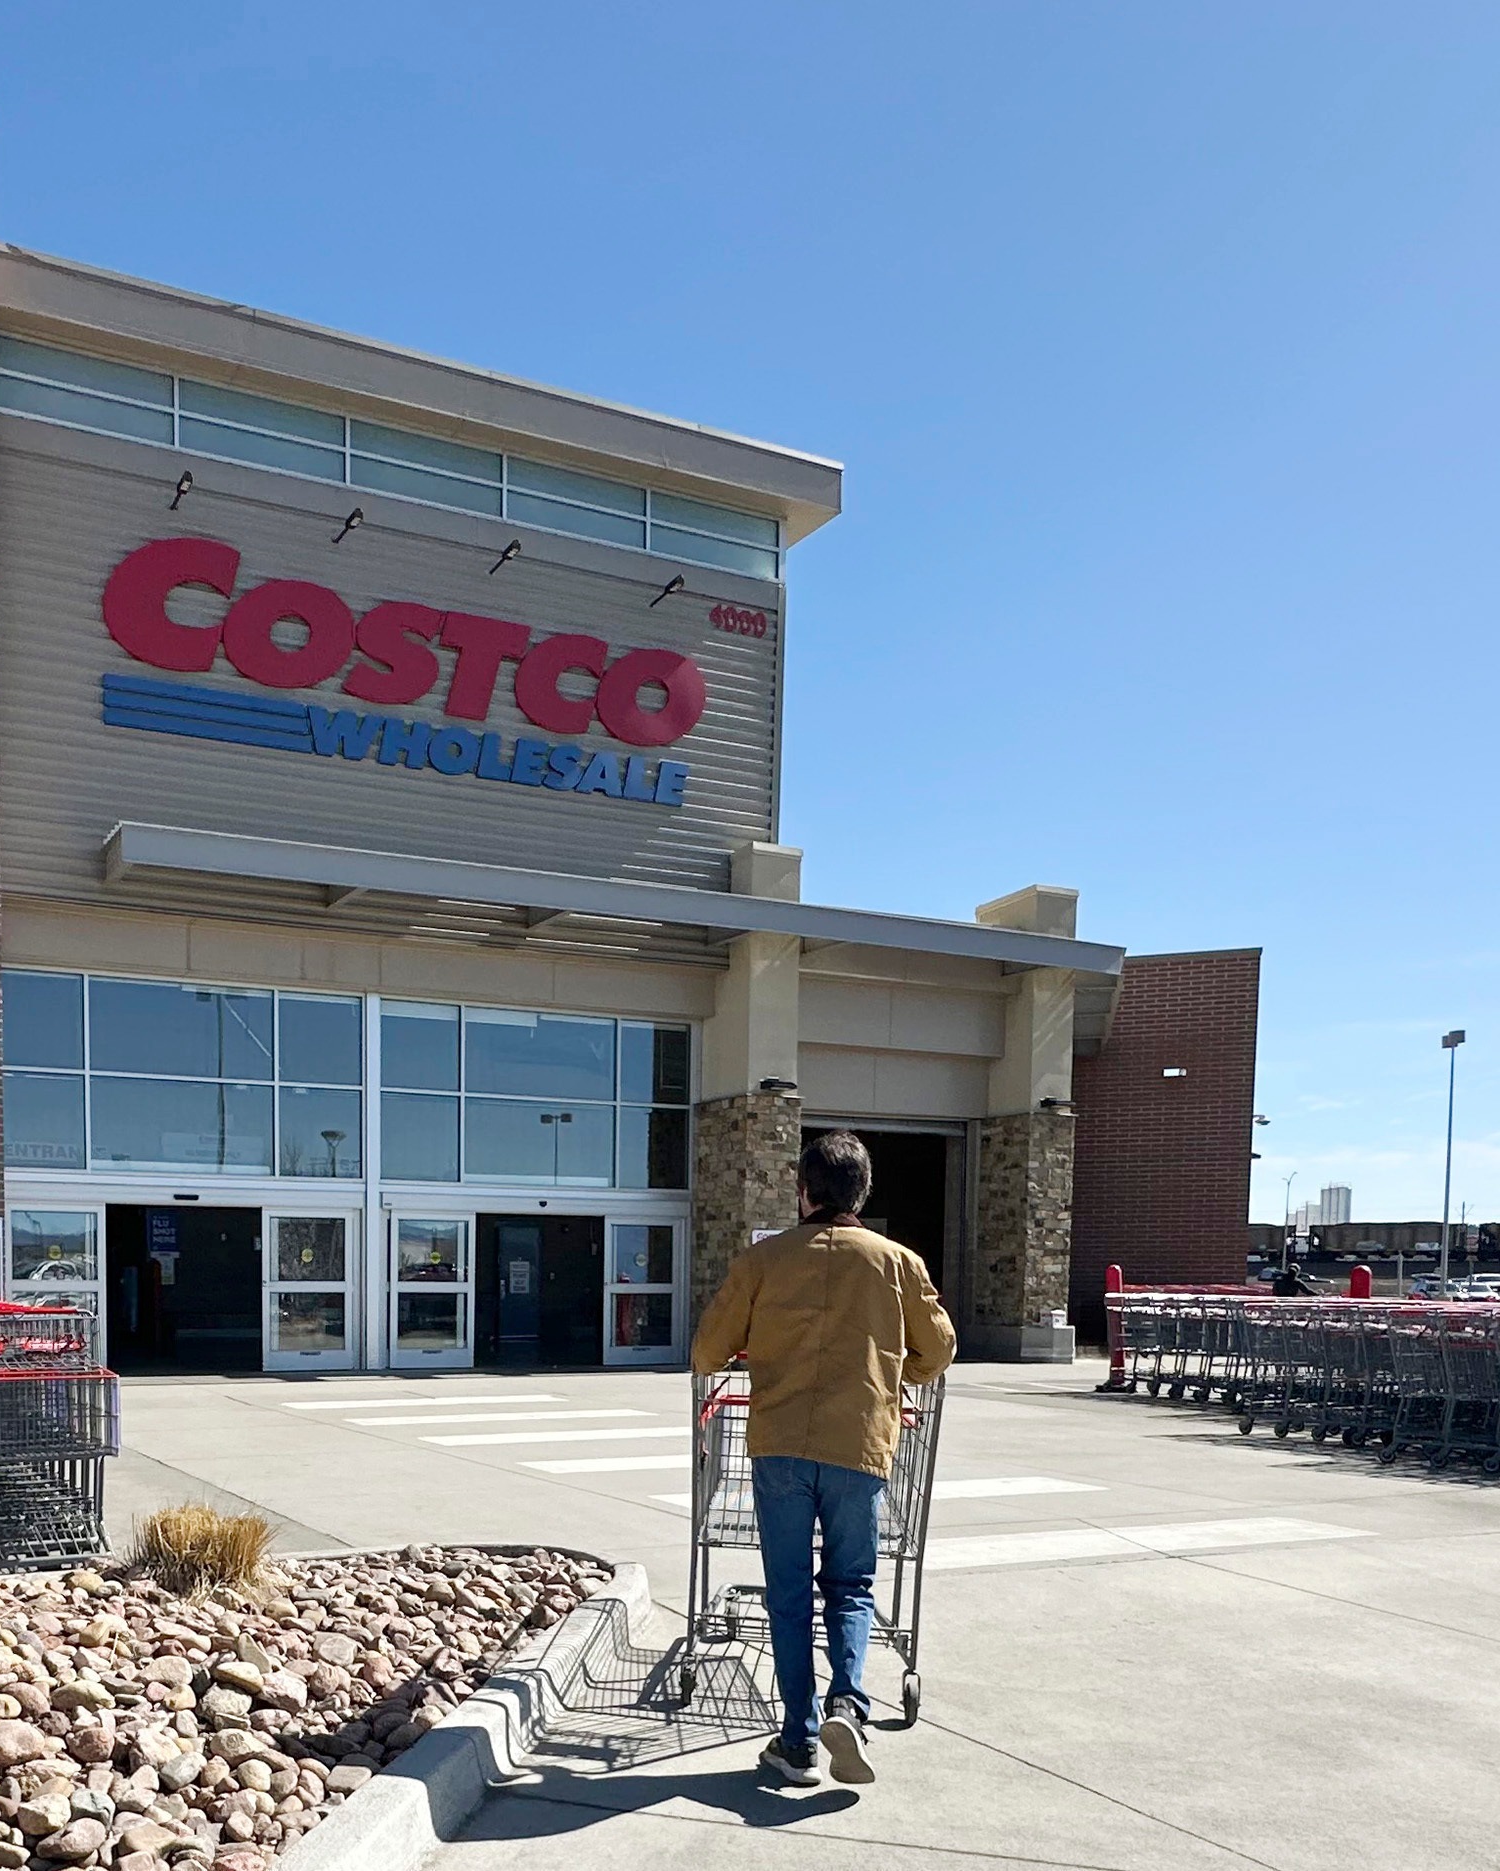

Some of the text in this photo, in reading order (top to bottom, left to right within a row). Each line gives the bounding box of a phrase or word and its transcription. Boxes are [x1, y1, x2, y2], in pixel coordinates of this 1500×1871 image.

[102, 537, 706, 747] COSTCO
[306, 705, 689, 807] WHOLESALE
[4, 1142, 107, 1160] ENTRAN
